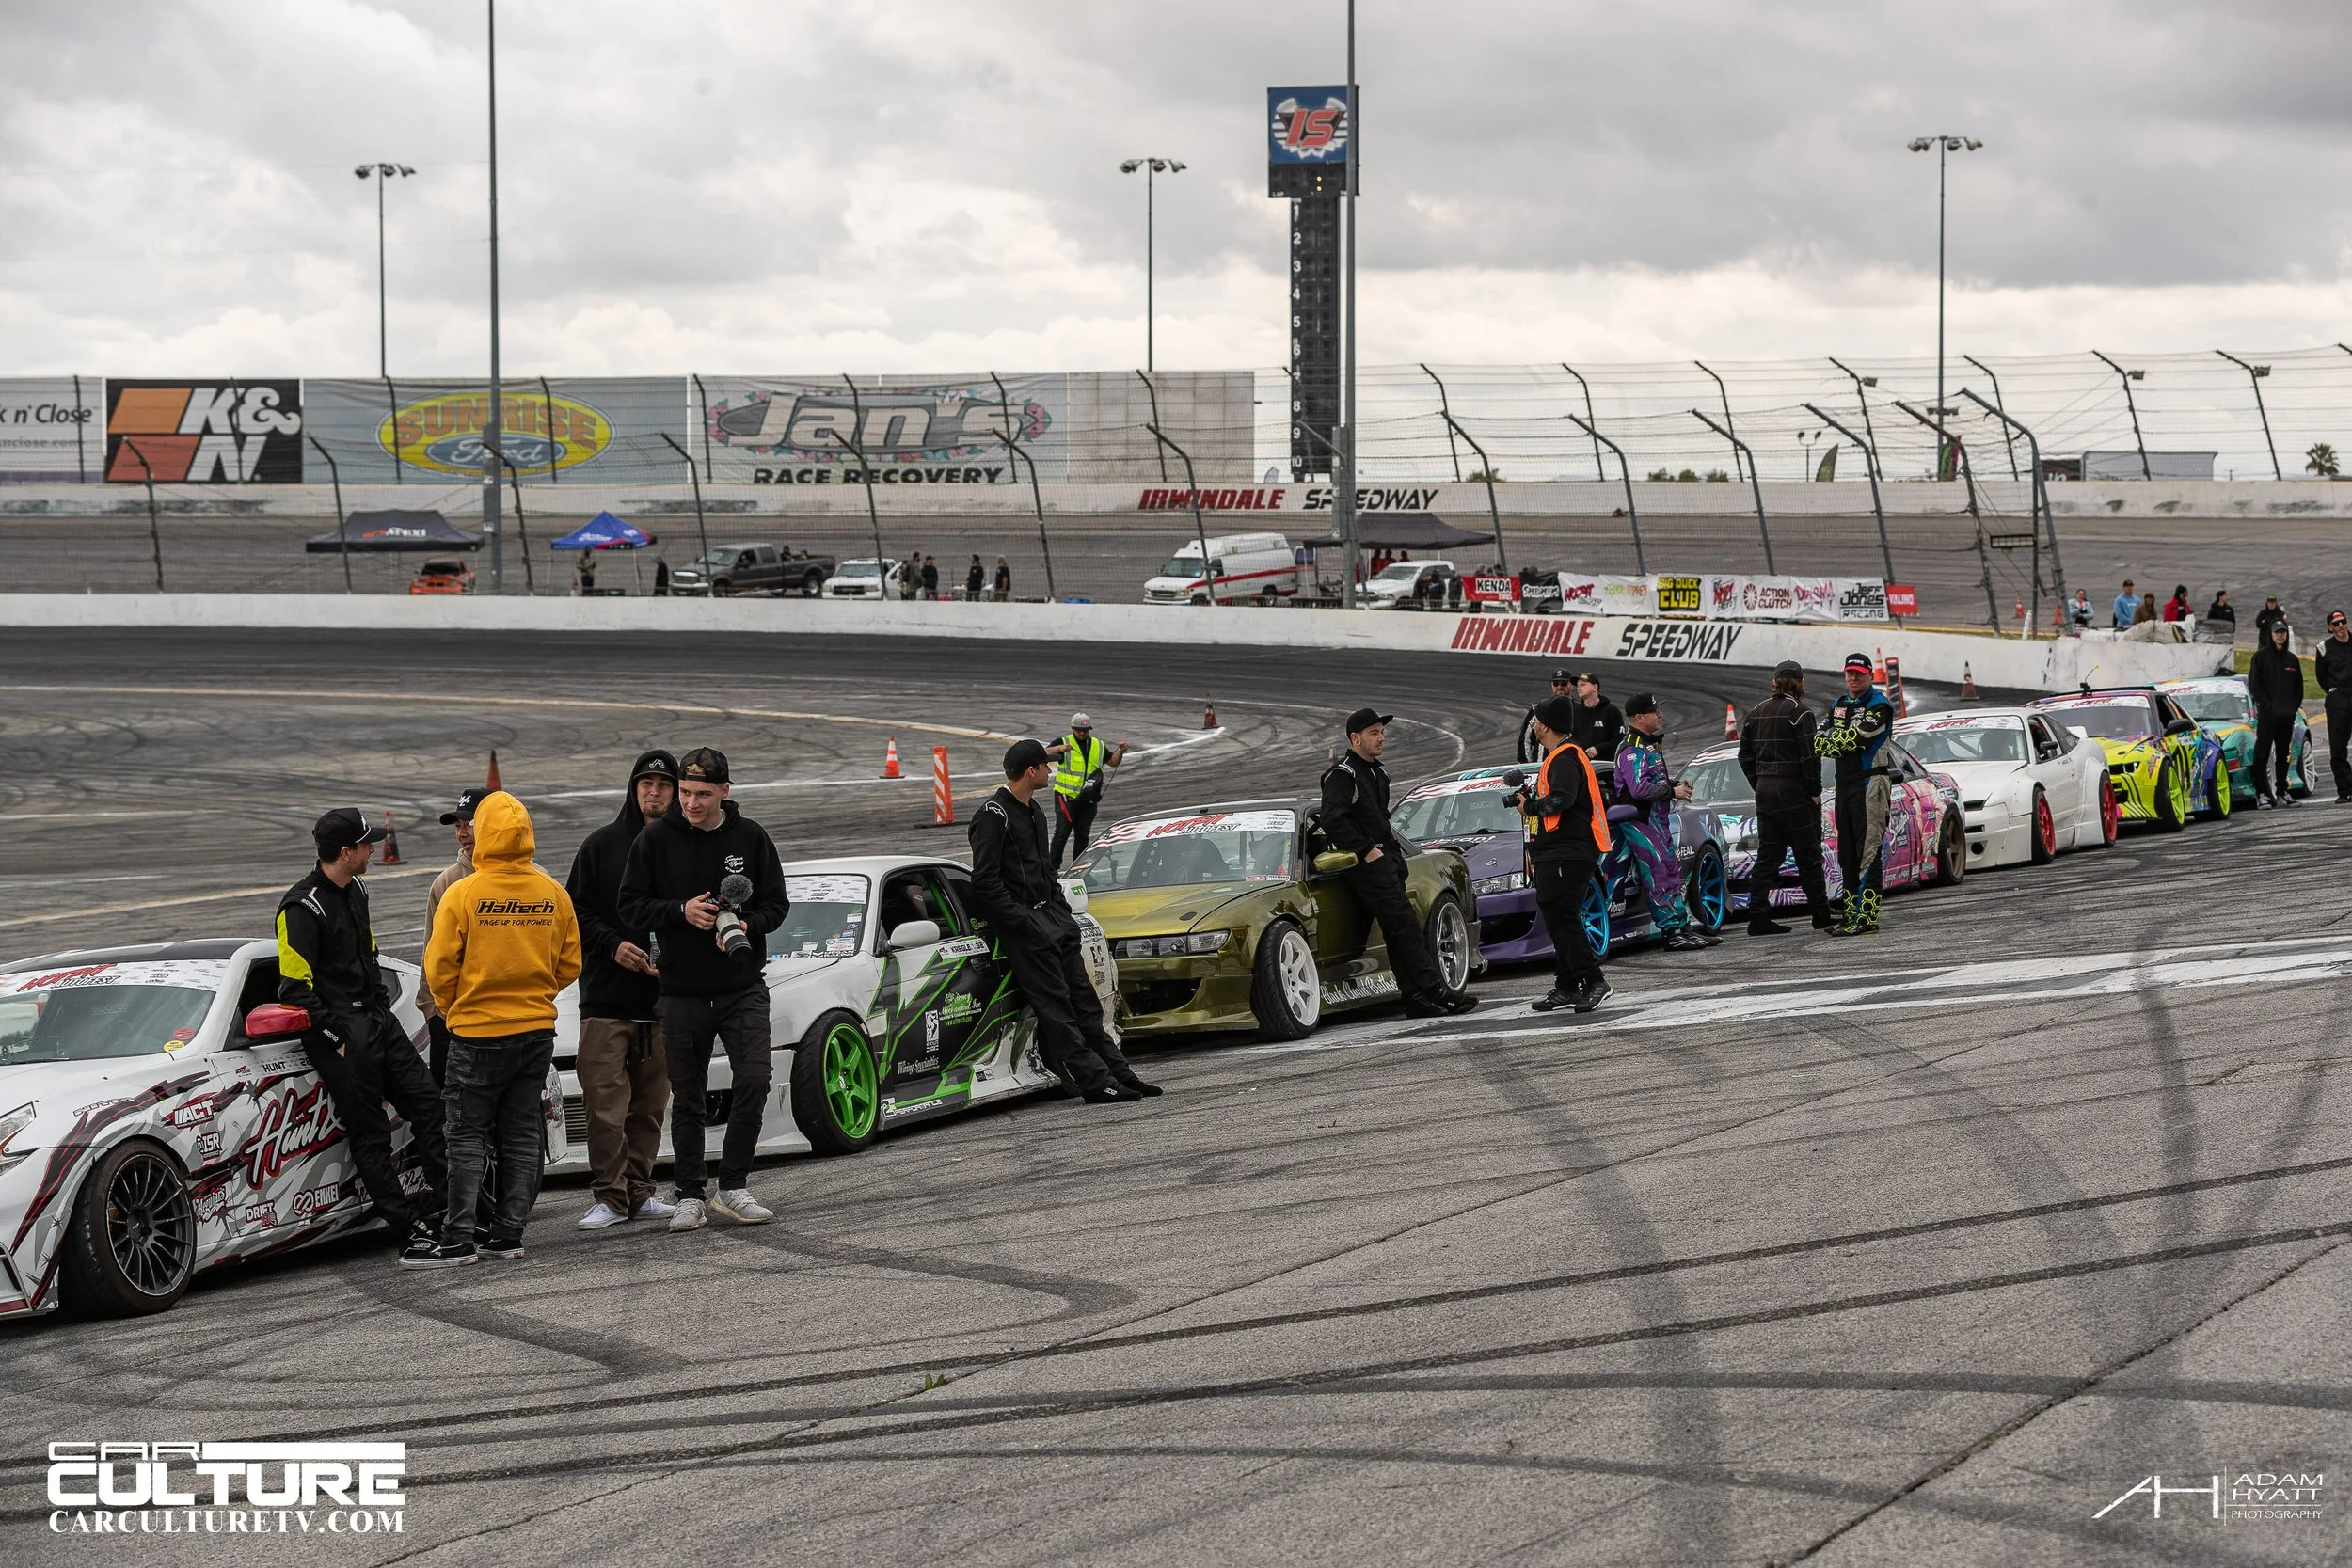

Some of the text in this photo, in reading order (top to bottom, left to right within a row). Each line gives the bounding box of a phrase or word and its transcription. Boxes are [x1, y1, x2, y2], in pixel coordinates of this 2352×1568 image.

[1293, 204, 1299, 217] 1
[1293, 231, 1302, 245] 2
[1293, 260, 1302, 273] 3
[1292, 287, 1301, 300] 4
[1293, 315, 1301, 328] 5
[1293, 343, 1301, 356] 6
[1293, 400, 1301, 412] 8
[36, 404, 92, 424] Close
[728, 393, 1025, 447] Jan's
[396, 397, 598, 451] SUNRISE
[1293, 427, 1301, 439] 9
[1291, 455, 1303, 467] 10
[754, 468, 1004, 483] RACE RECOVERY
[1138, 489, 1285, 510] IRWINDALE
[1476, 578, 1511, 593] KENDA
[1658, 578, 1674, 589] BIG
[1660, 591, 1699, 609] CLUB
[1760, 588, 1789, 598] ACTION
[1758, 598, 1792, 609] CLUTCH
[1450, 617, 1743, 660] IRWINDALE SPEEDWAY
[476, 900, 555, 914] Haltech
[17, 963, 118, 992] HOTPIT
[51, 975, 121, 989] AUTOFEST
[262, 1060, 287, 1072] HUNT
[895, 1099, 943, 1116] PERFORMANCE
[314, 1184, 339, 1208] ENKEI
[246, 1202, 275, 1221] DRIFT
